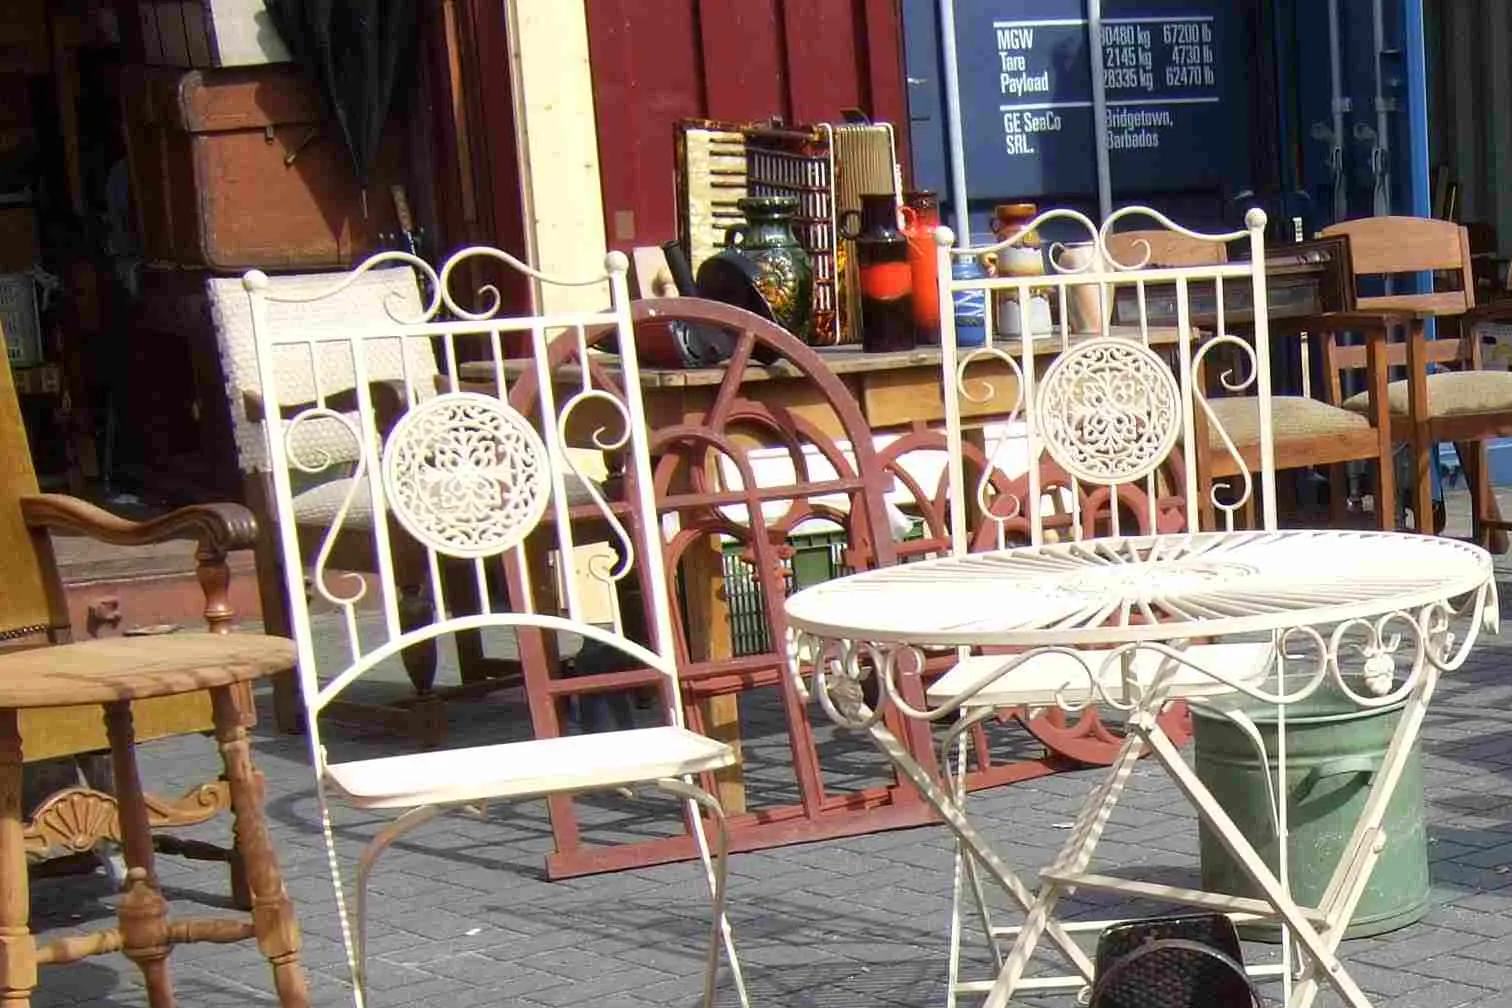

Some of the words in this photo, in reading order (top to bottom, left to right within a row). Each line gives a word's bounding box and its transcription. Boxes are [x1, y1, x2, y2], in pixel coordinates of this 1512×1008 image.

[996, 28, 1034, 49] MGW
[1137, 25, 1151, 48] kg
[1163, 24, 1199, 44] 67200
[1202, 23, 1212, 42] lb
[999, 51, 1026, 72] Tare
[1106, 46, 1136, 67] 2145
[1138, 46, 1152, 70] kg
[1172, 45, 1201, 64] 4730
[1203, 45, 1213, 63] lb
[1000, 70, 1049, 97] Payload
[1103, 68, 1138, 88] 28335
[1140, 67, 1154, 91] kg
[1166, 66, 1202, 86] 62470
[1204, 66, 1215, 85] lb
[1004, 112, 1022, 133] GE
[1023, 111, 1062, 132] SeaCo
[1105, 107, 1173, 130] Bridgetown,
[1006, 133, 1034, 155] SRL.
[1105, 129, 1159, 150] Barbados
